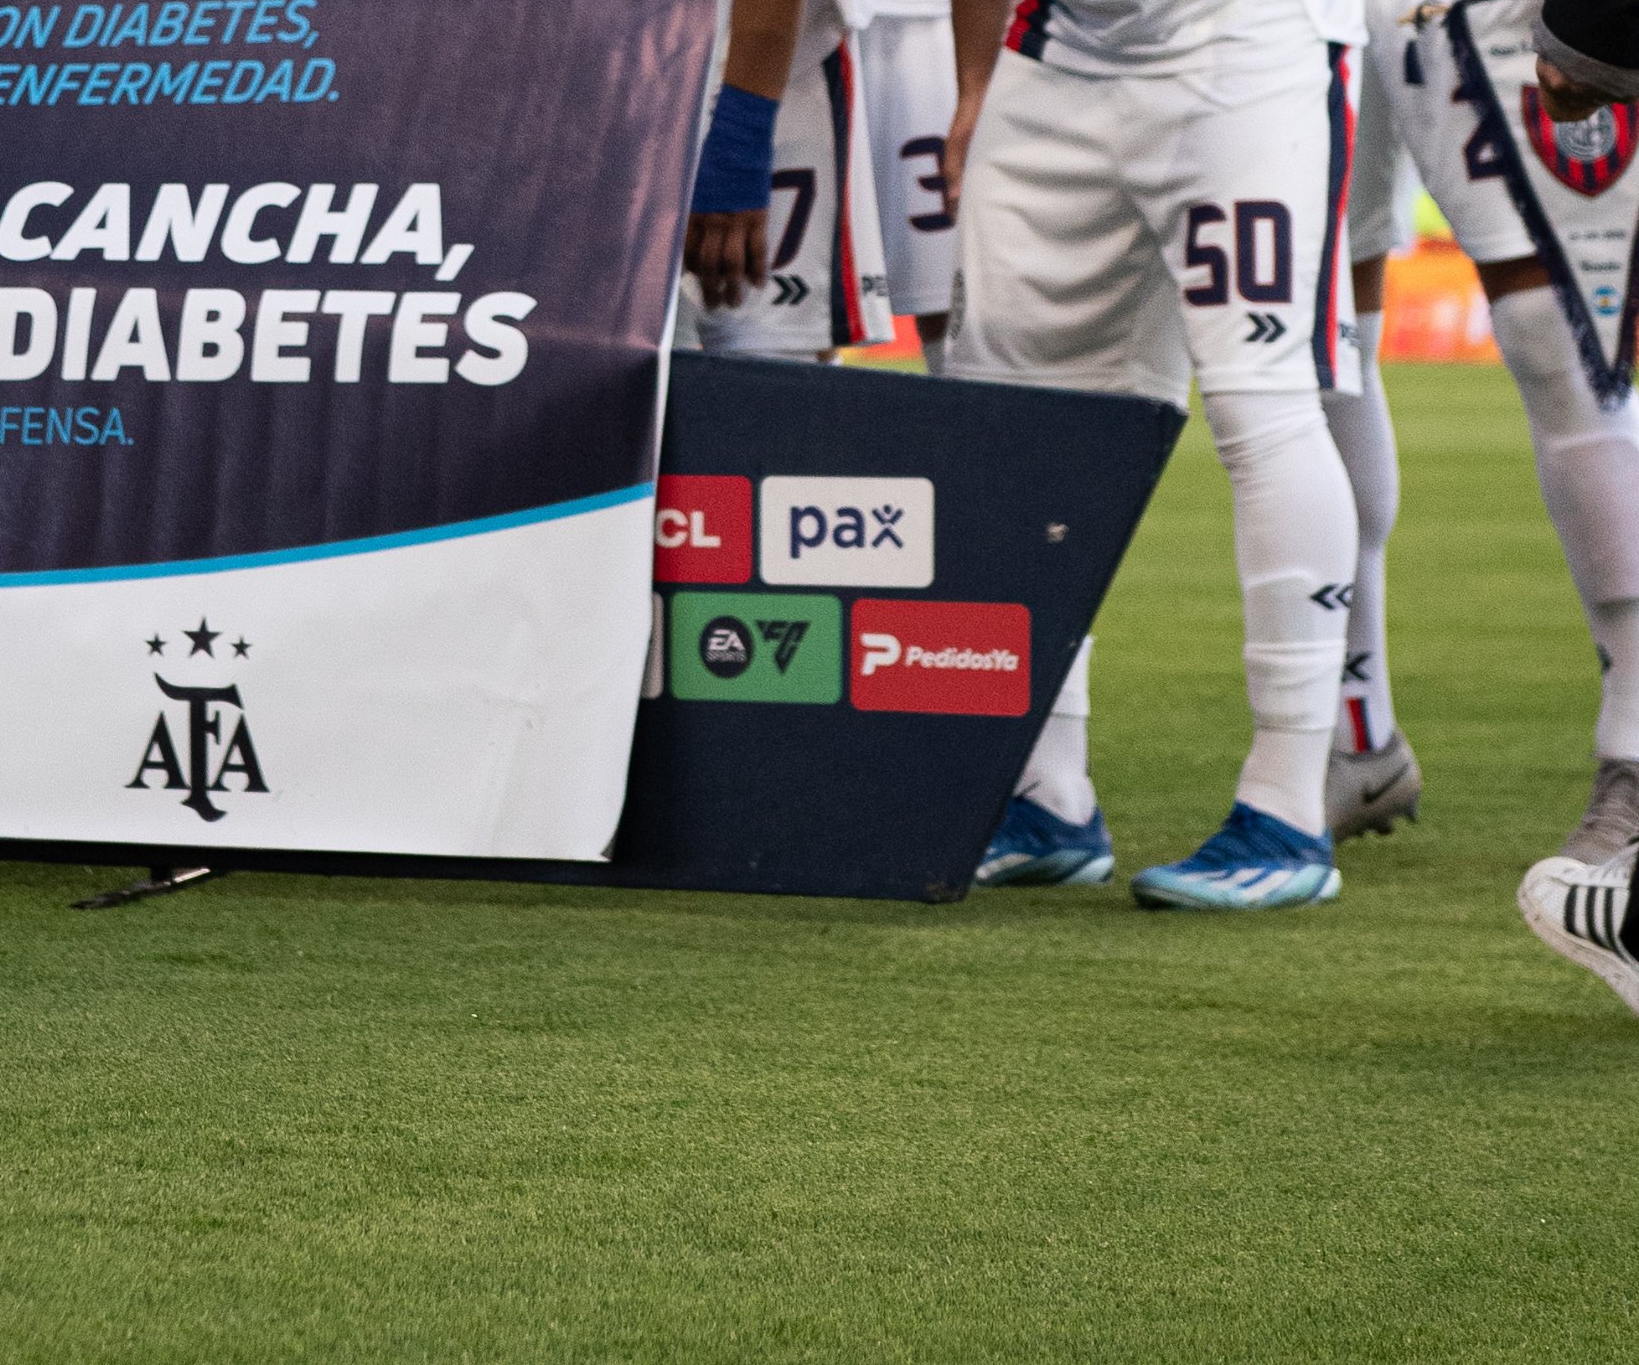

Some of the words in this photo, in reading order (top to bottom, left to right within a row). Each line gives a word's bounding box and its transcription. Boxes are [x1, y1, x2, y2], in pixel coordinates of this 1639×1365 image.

[1185, 200, 1293, 307] 50
[790, 504, 905, 559] pax
[906, 645, 1019, 671] PedidosYa
